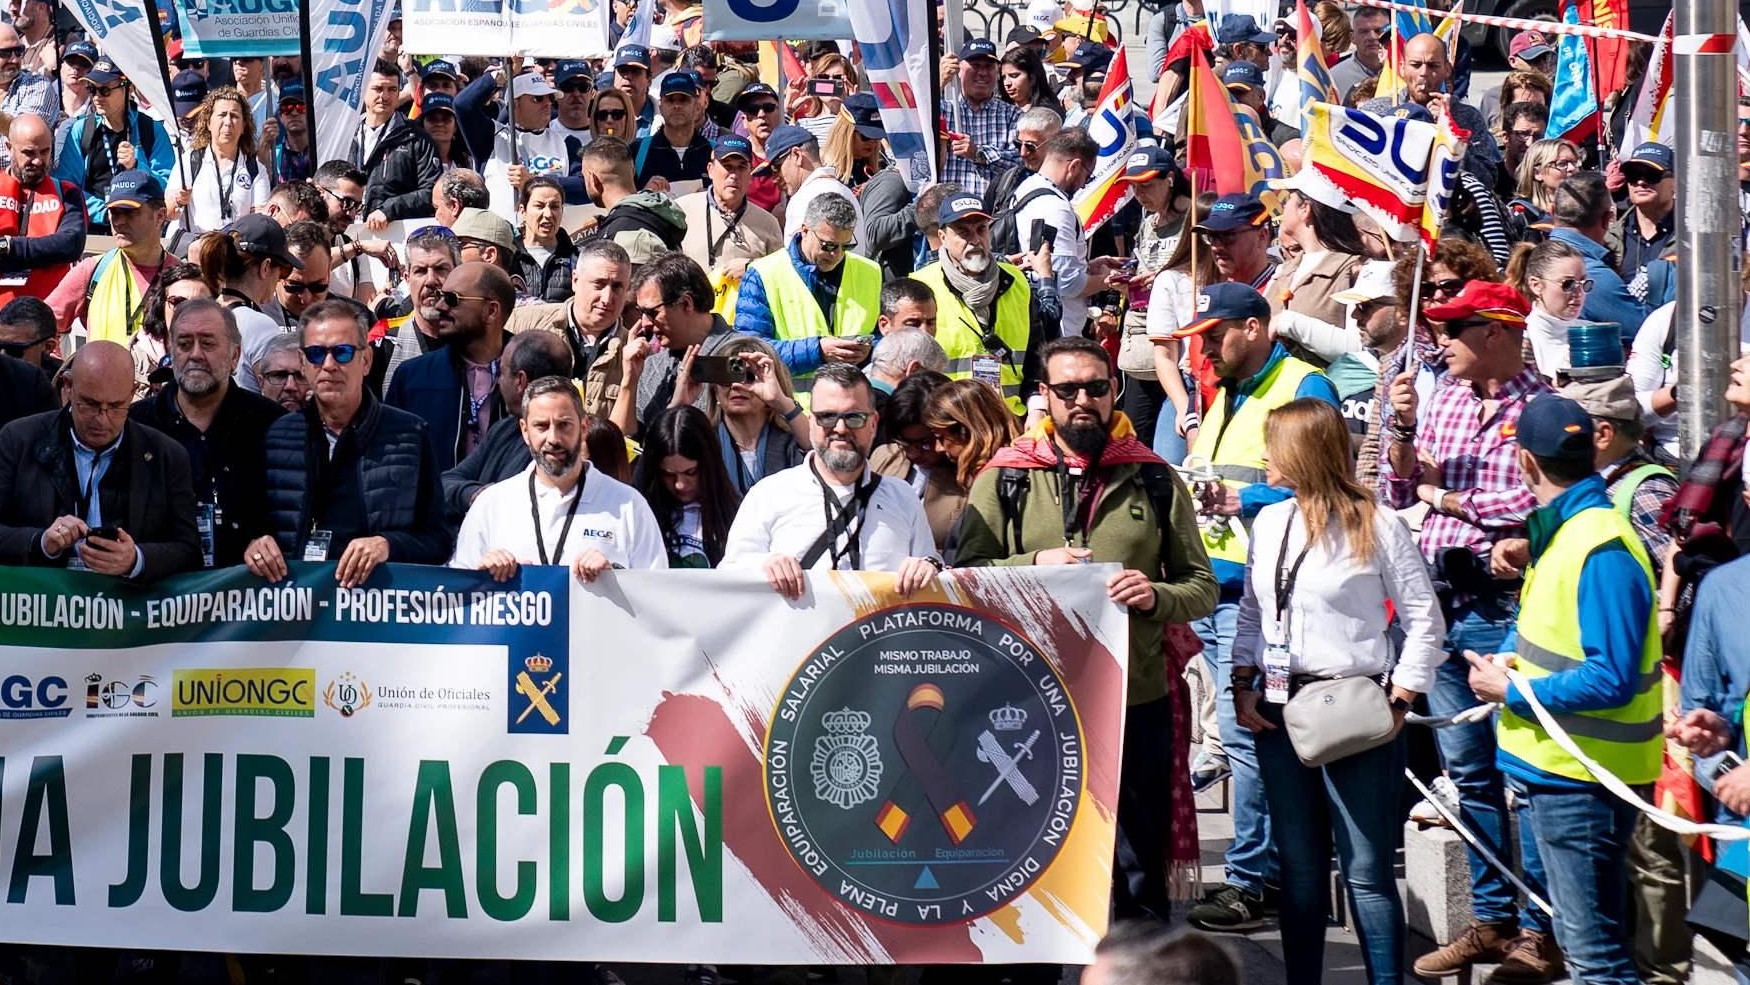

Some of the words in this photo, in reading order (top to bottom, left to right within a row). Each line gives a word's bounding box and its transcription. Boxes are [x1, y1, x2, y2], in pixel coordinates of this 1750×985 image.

[214, 16, 268, 26] Asociación
[218, 28, 230, 38] de
[232, 26, 286, 38] Guardias
[116, 182, 136, 190] AUGC
[582, 528, 614, 538] AEGC
[146, 582, 312, 630] EQUIPARACIÓN
[335, 585, 464, 626] PROFESIÓN
[470, 590, 552, 628] RIESGO
[858, 610, 984, 640] PLATAFORMA
[879, 650, 918, 662] MISMO
[920, 649, 971, 662] TRABAJO
[998, 632, 1034, 667] POR
[874, 664, 912, 675] MISMA
[912, 660, 980, 674] JUBILACIÓN
[378, 686, 416, 699] Unión
[419, 686, 435, 700] de
[438, 687, 490, 701] Oficiales
[780, 644, 844, 724] SALARIAL
[1038, 674, 1066, 718] UNA
[1042, 732, 1078, 847] JUBILACIÓN
[767, 739, 828, 878] EQUIPARACIÓN
[108, 736, 724, 924] JUBILACIÓN
[850, 848, 916, 860] Jubilación
[935, 846, 1004, 860] Equiparación
[984, 856, 1041, 904] DIGNA
[840, 878, 899, 918] PLENA
[962, 900, 974, 916] Y
[917, 904, 942, 920] LA
